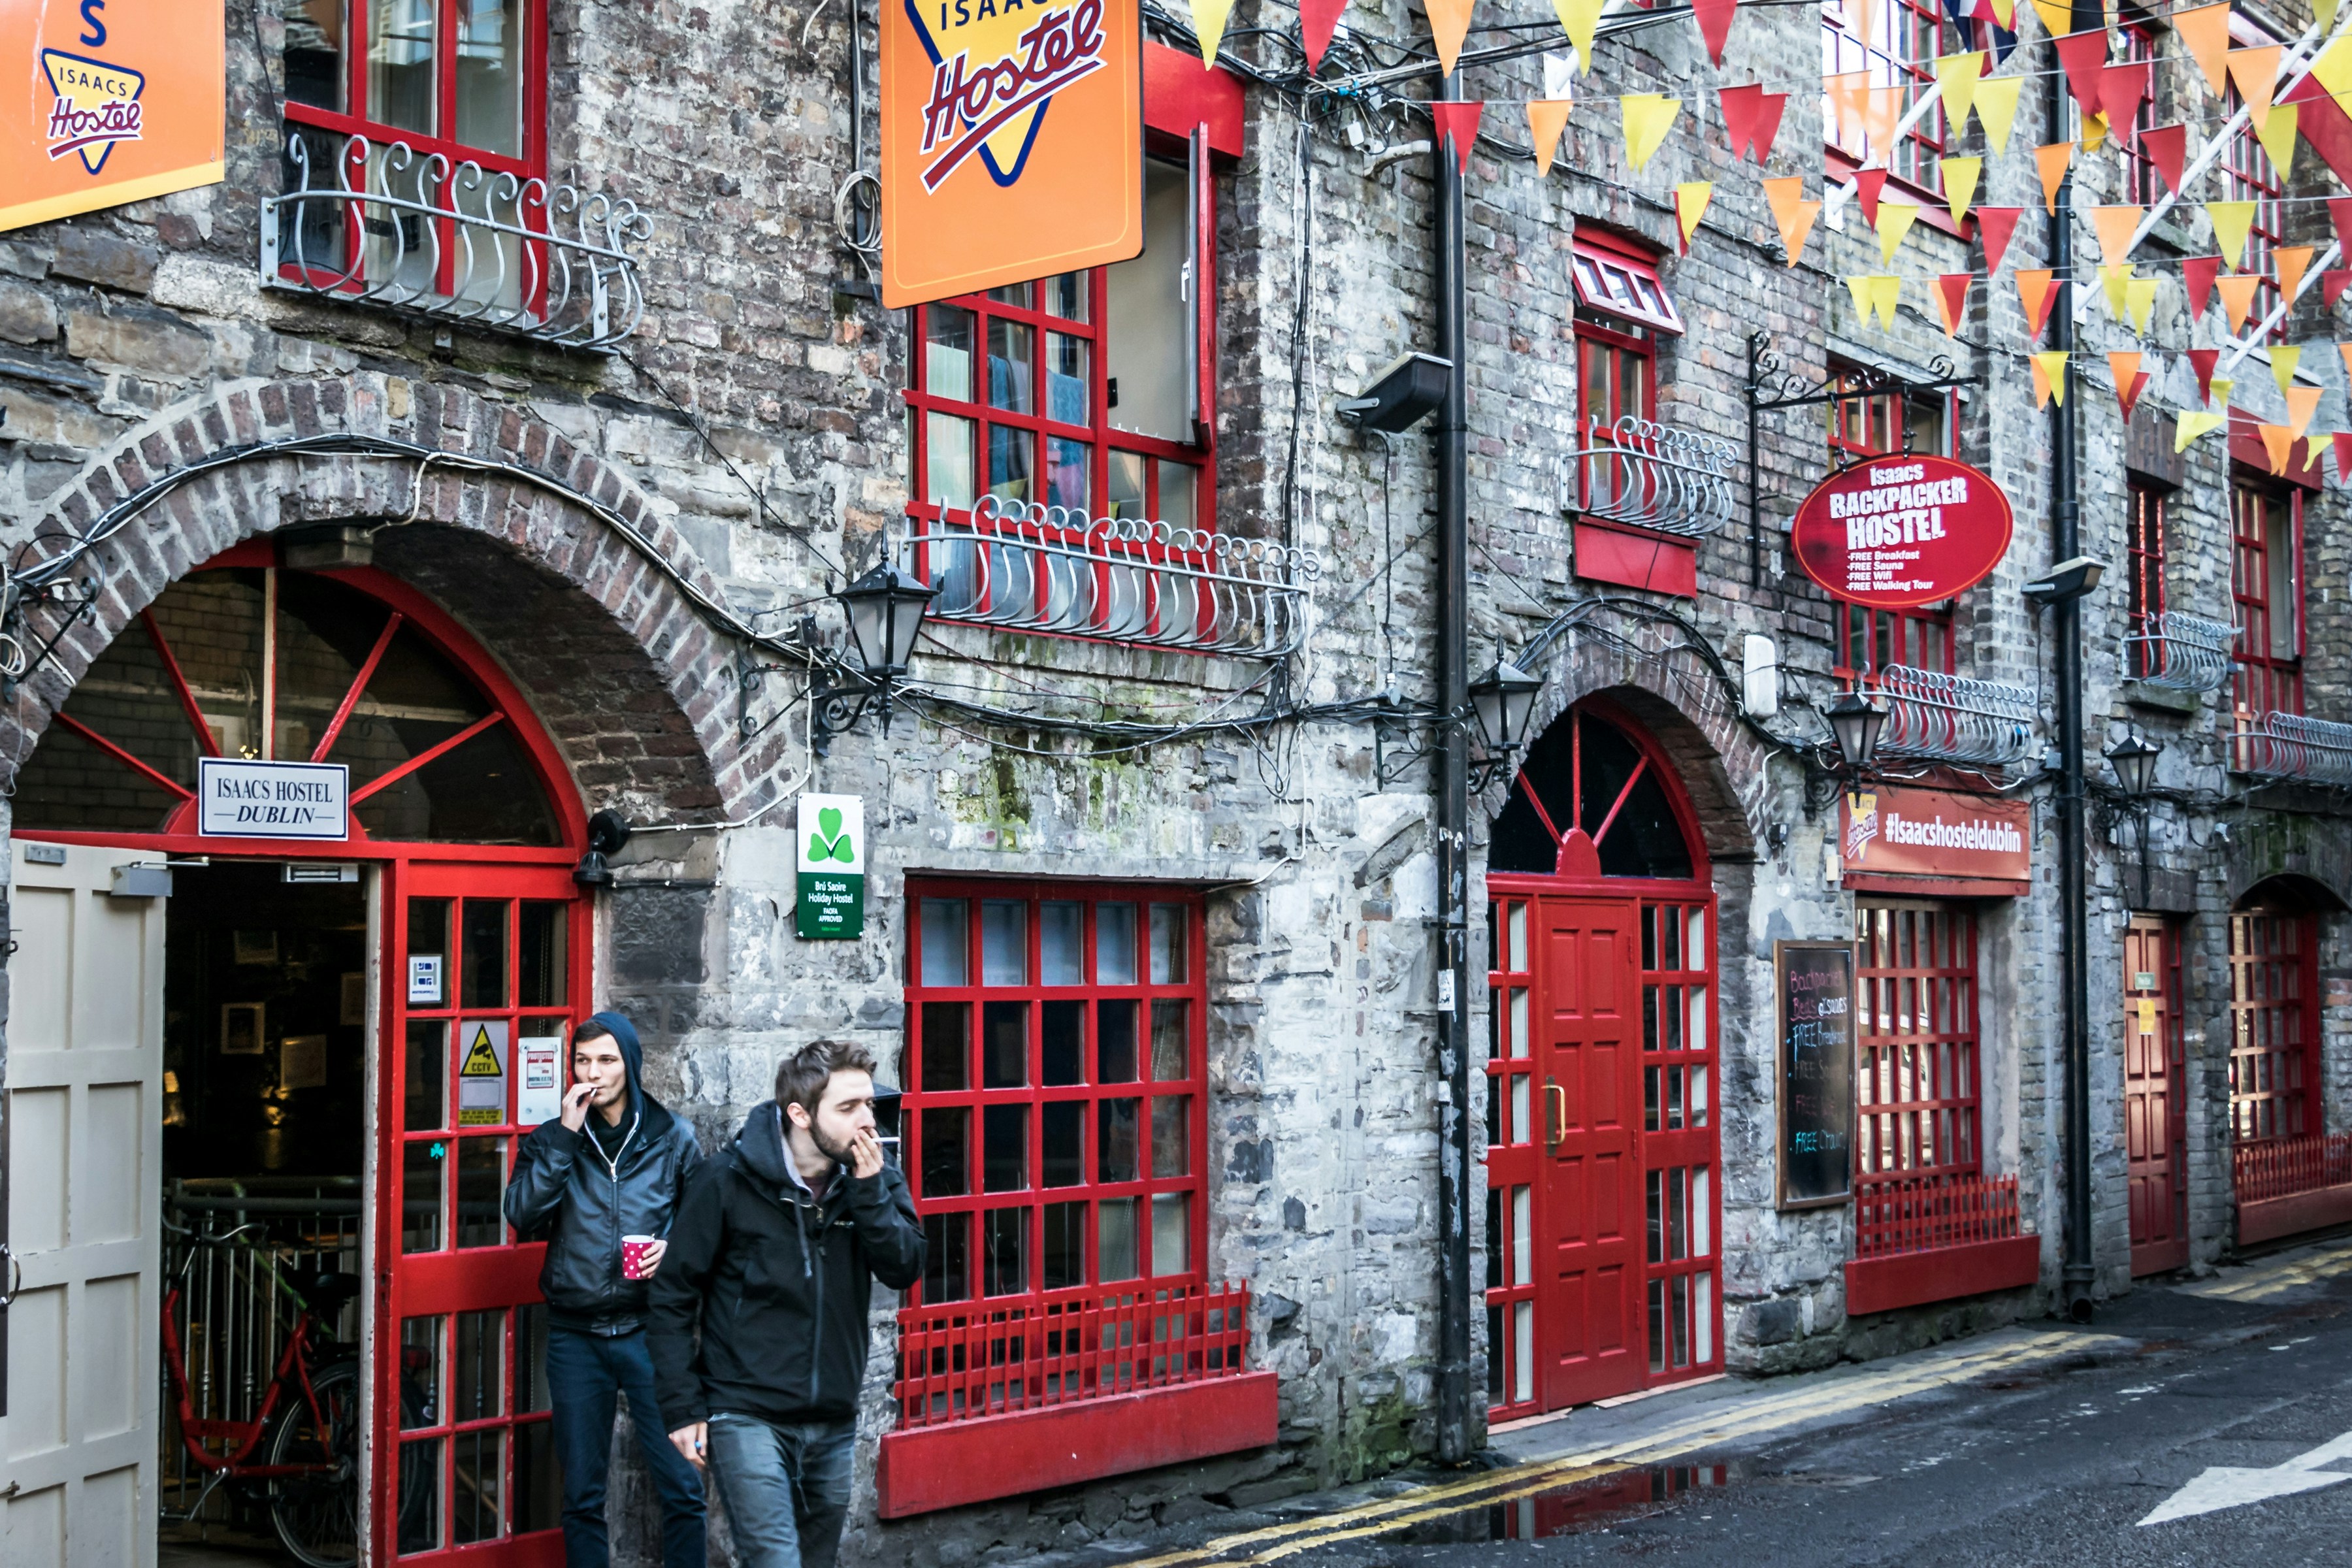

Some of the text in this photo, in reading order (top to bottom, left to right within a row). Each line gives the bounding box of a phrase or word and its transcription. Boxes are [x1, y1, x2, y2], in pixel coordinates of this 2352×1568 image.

[59, 67, 127, 97] ISAACS
[923, 0, 1103, 151] Hostel
[50, 98, 140, 137] Hostel
[1870, 464, 1924, 486] Isaacs
[1829, 476, 1967, 519] BACKPACKER
[1846, 507, 1946, 550] HOSTEL
[1873, 561, 1904, 570] Sauna
[1874, 550, 1919, 561] Breakfast
[1872, 581, 1911, 592] Walking
[1912, 580, 1933, 589] Tour
[217, 778, 333, 802] ISAACS HOSTEL
[237, 806, 316, 824] DUBLIN
[1886, 813, 2021, 853] #Isaacshosteldublin
[815, 881, 847, 892] Brú Saoire
[808, 892, 853, 906] Holiday Hostel
[1793, 1022, 1816, 1060] FREE
[472, 1062, 491, 1072] CCTV
[1795, 1131, 1817, 1154] FREE
